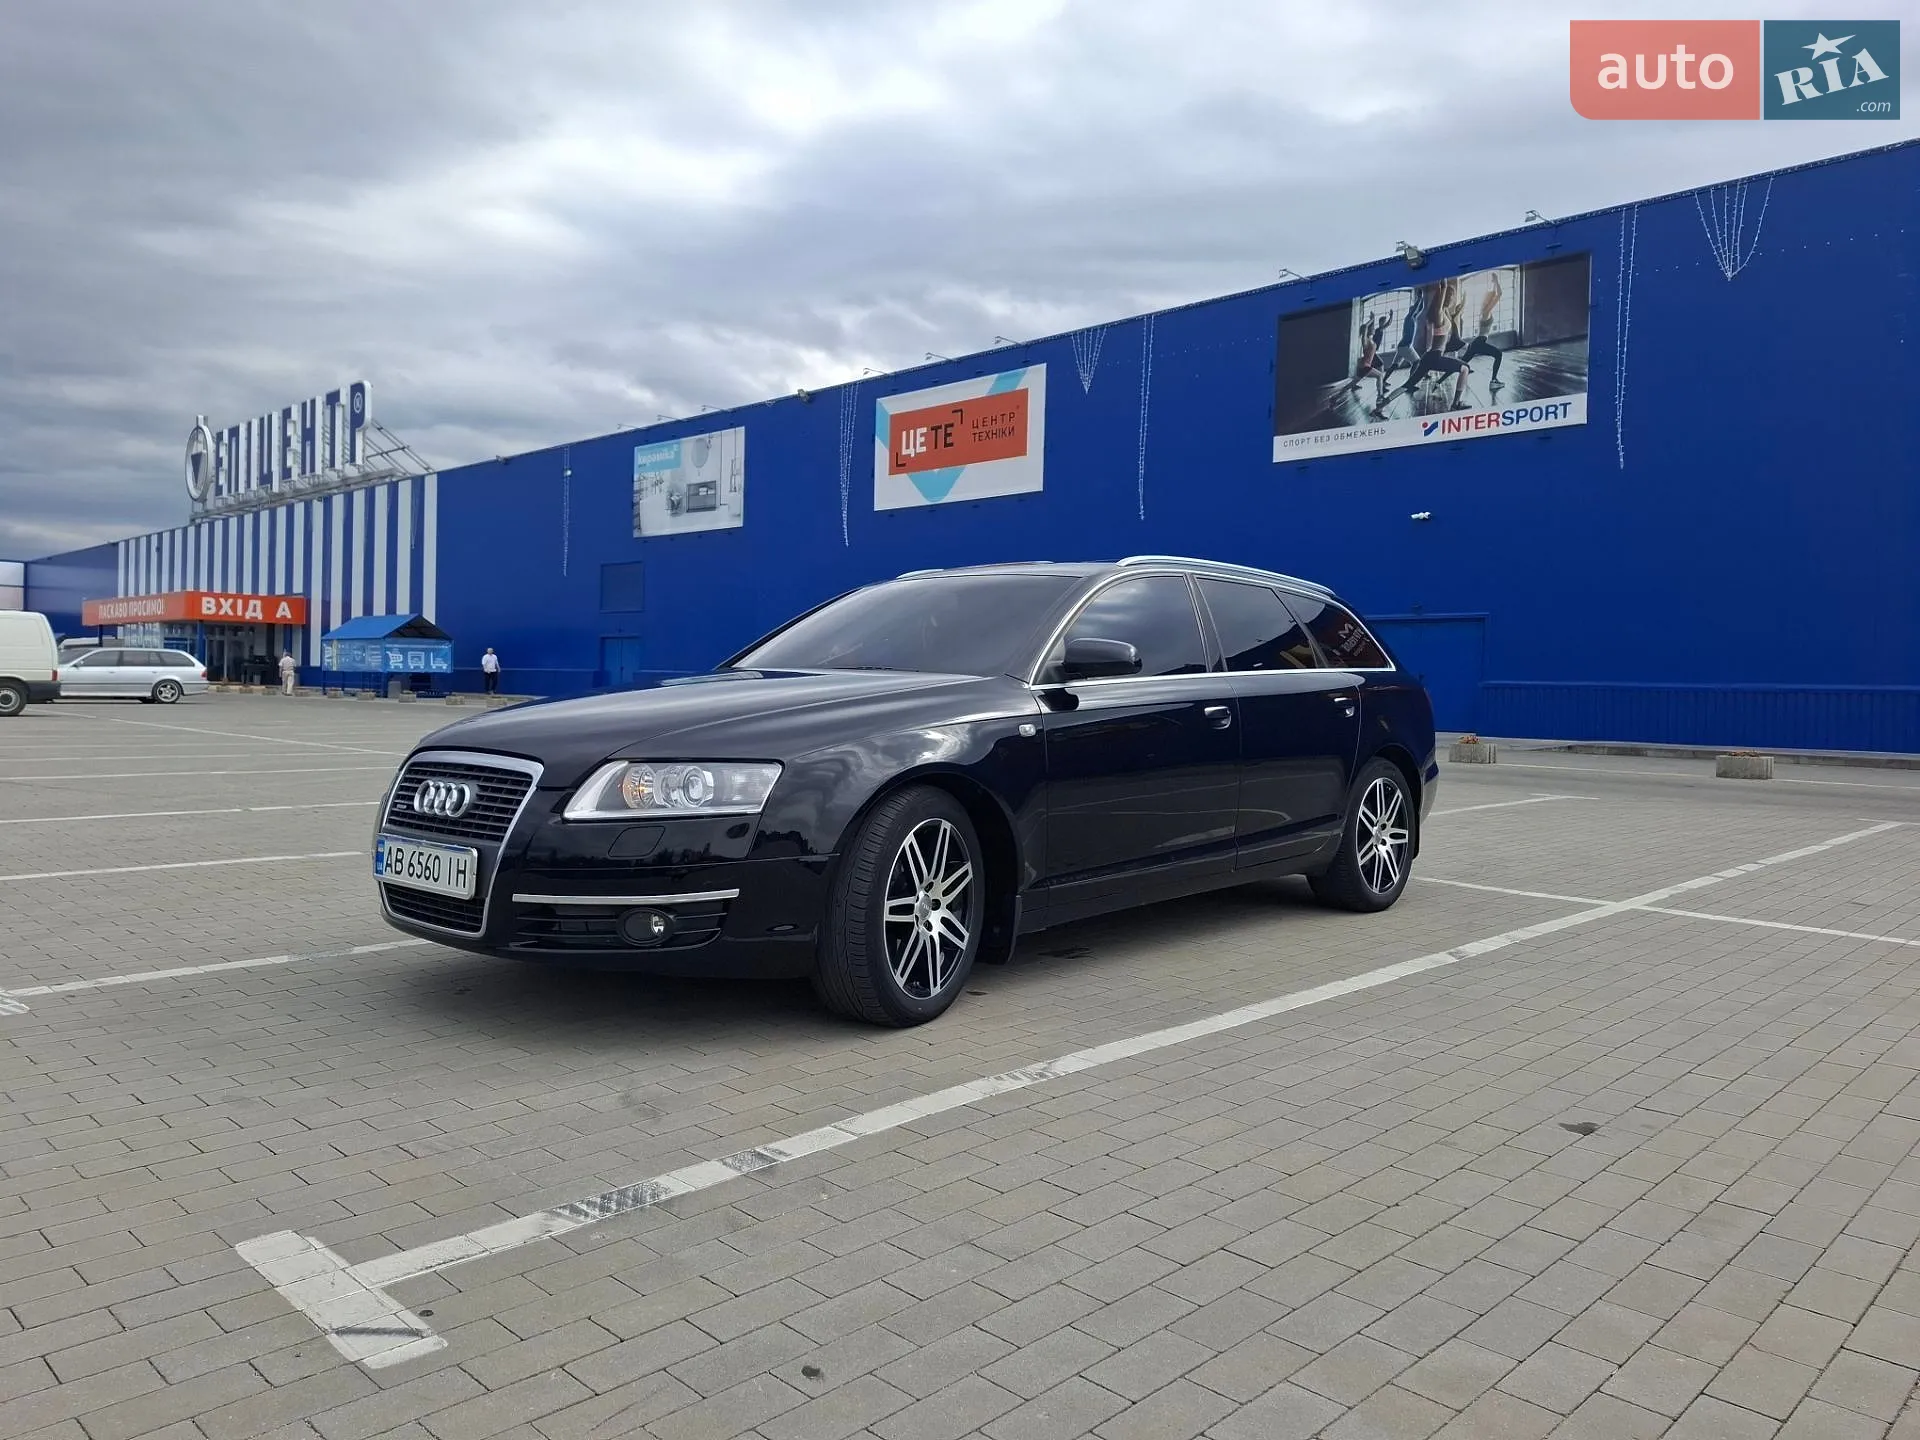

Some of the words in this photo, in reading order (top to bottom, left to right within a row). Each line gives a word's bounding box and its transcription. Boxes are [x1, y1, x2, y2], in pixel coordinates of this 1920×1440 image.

[972, 411, 1016, 429] ЦЕНТР
[1440, 402, 1572, 435] INTERSPORT
[215, 380, 371, 497] ЕПІЦЕНТР
[972, 426, 1015, 443] ТЕХНІКИ
[1283, 436, 1311, 448] СПОРТ
[1314, 433, 1331, 444] БЕЗ
[1333, 426, 1387, 442] ОБМЕЖЕНЬ
[201, 596, 263, 620] ВХІД
[384, 846, 405, 876] AB
[408, 851, 441, 882] 6560
[448, 856, 467, 889] IH
